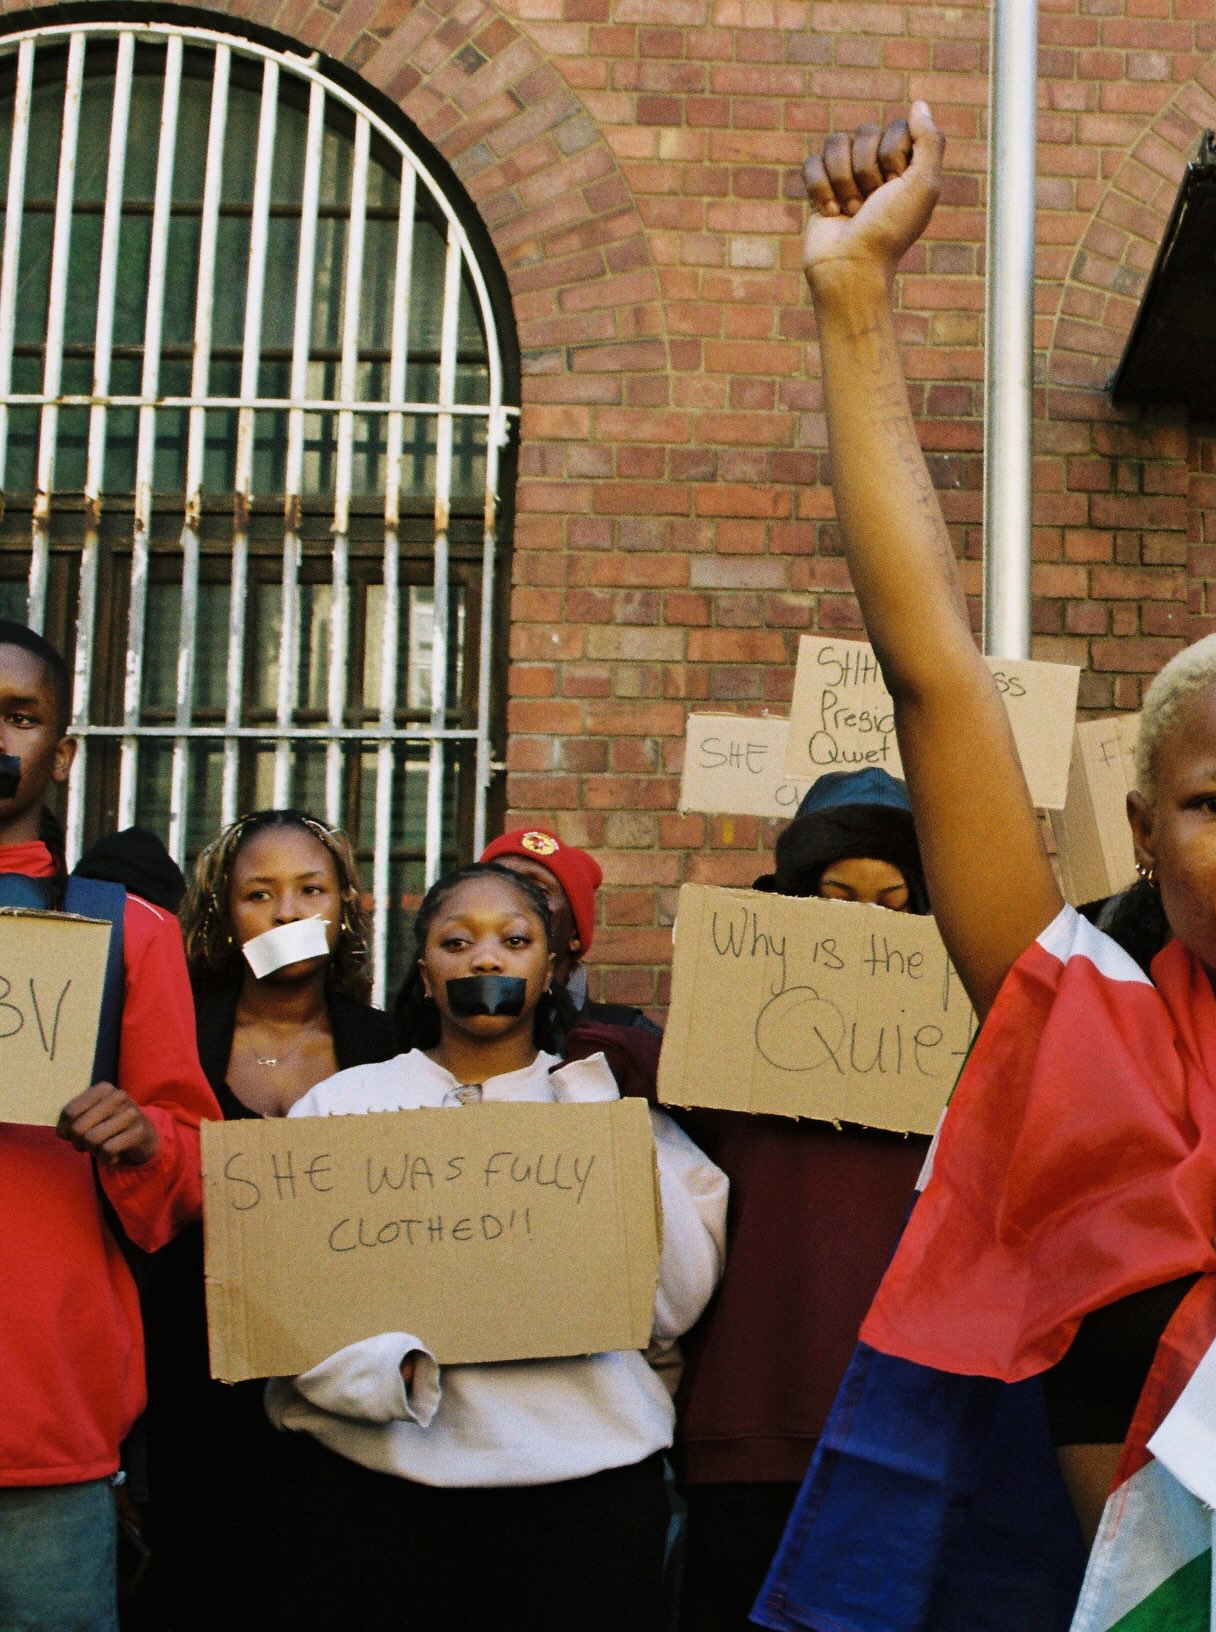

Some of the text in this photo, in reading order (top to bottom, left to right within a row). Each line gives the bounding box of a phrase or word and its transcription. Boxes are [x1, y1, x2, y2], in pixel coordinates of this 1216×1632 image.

[699, 737, 769, 774] SHE
[713, 907, 787, 998] Why
[863, 934, 924, 979] the
[223, 1152, 335, 1210] SHE
[366, 1153, 464, 1194] WAS
